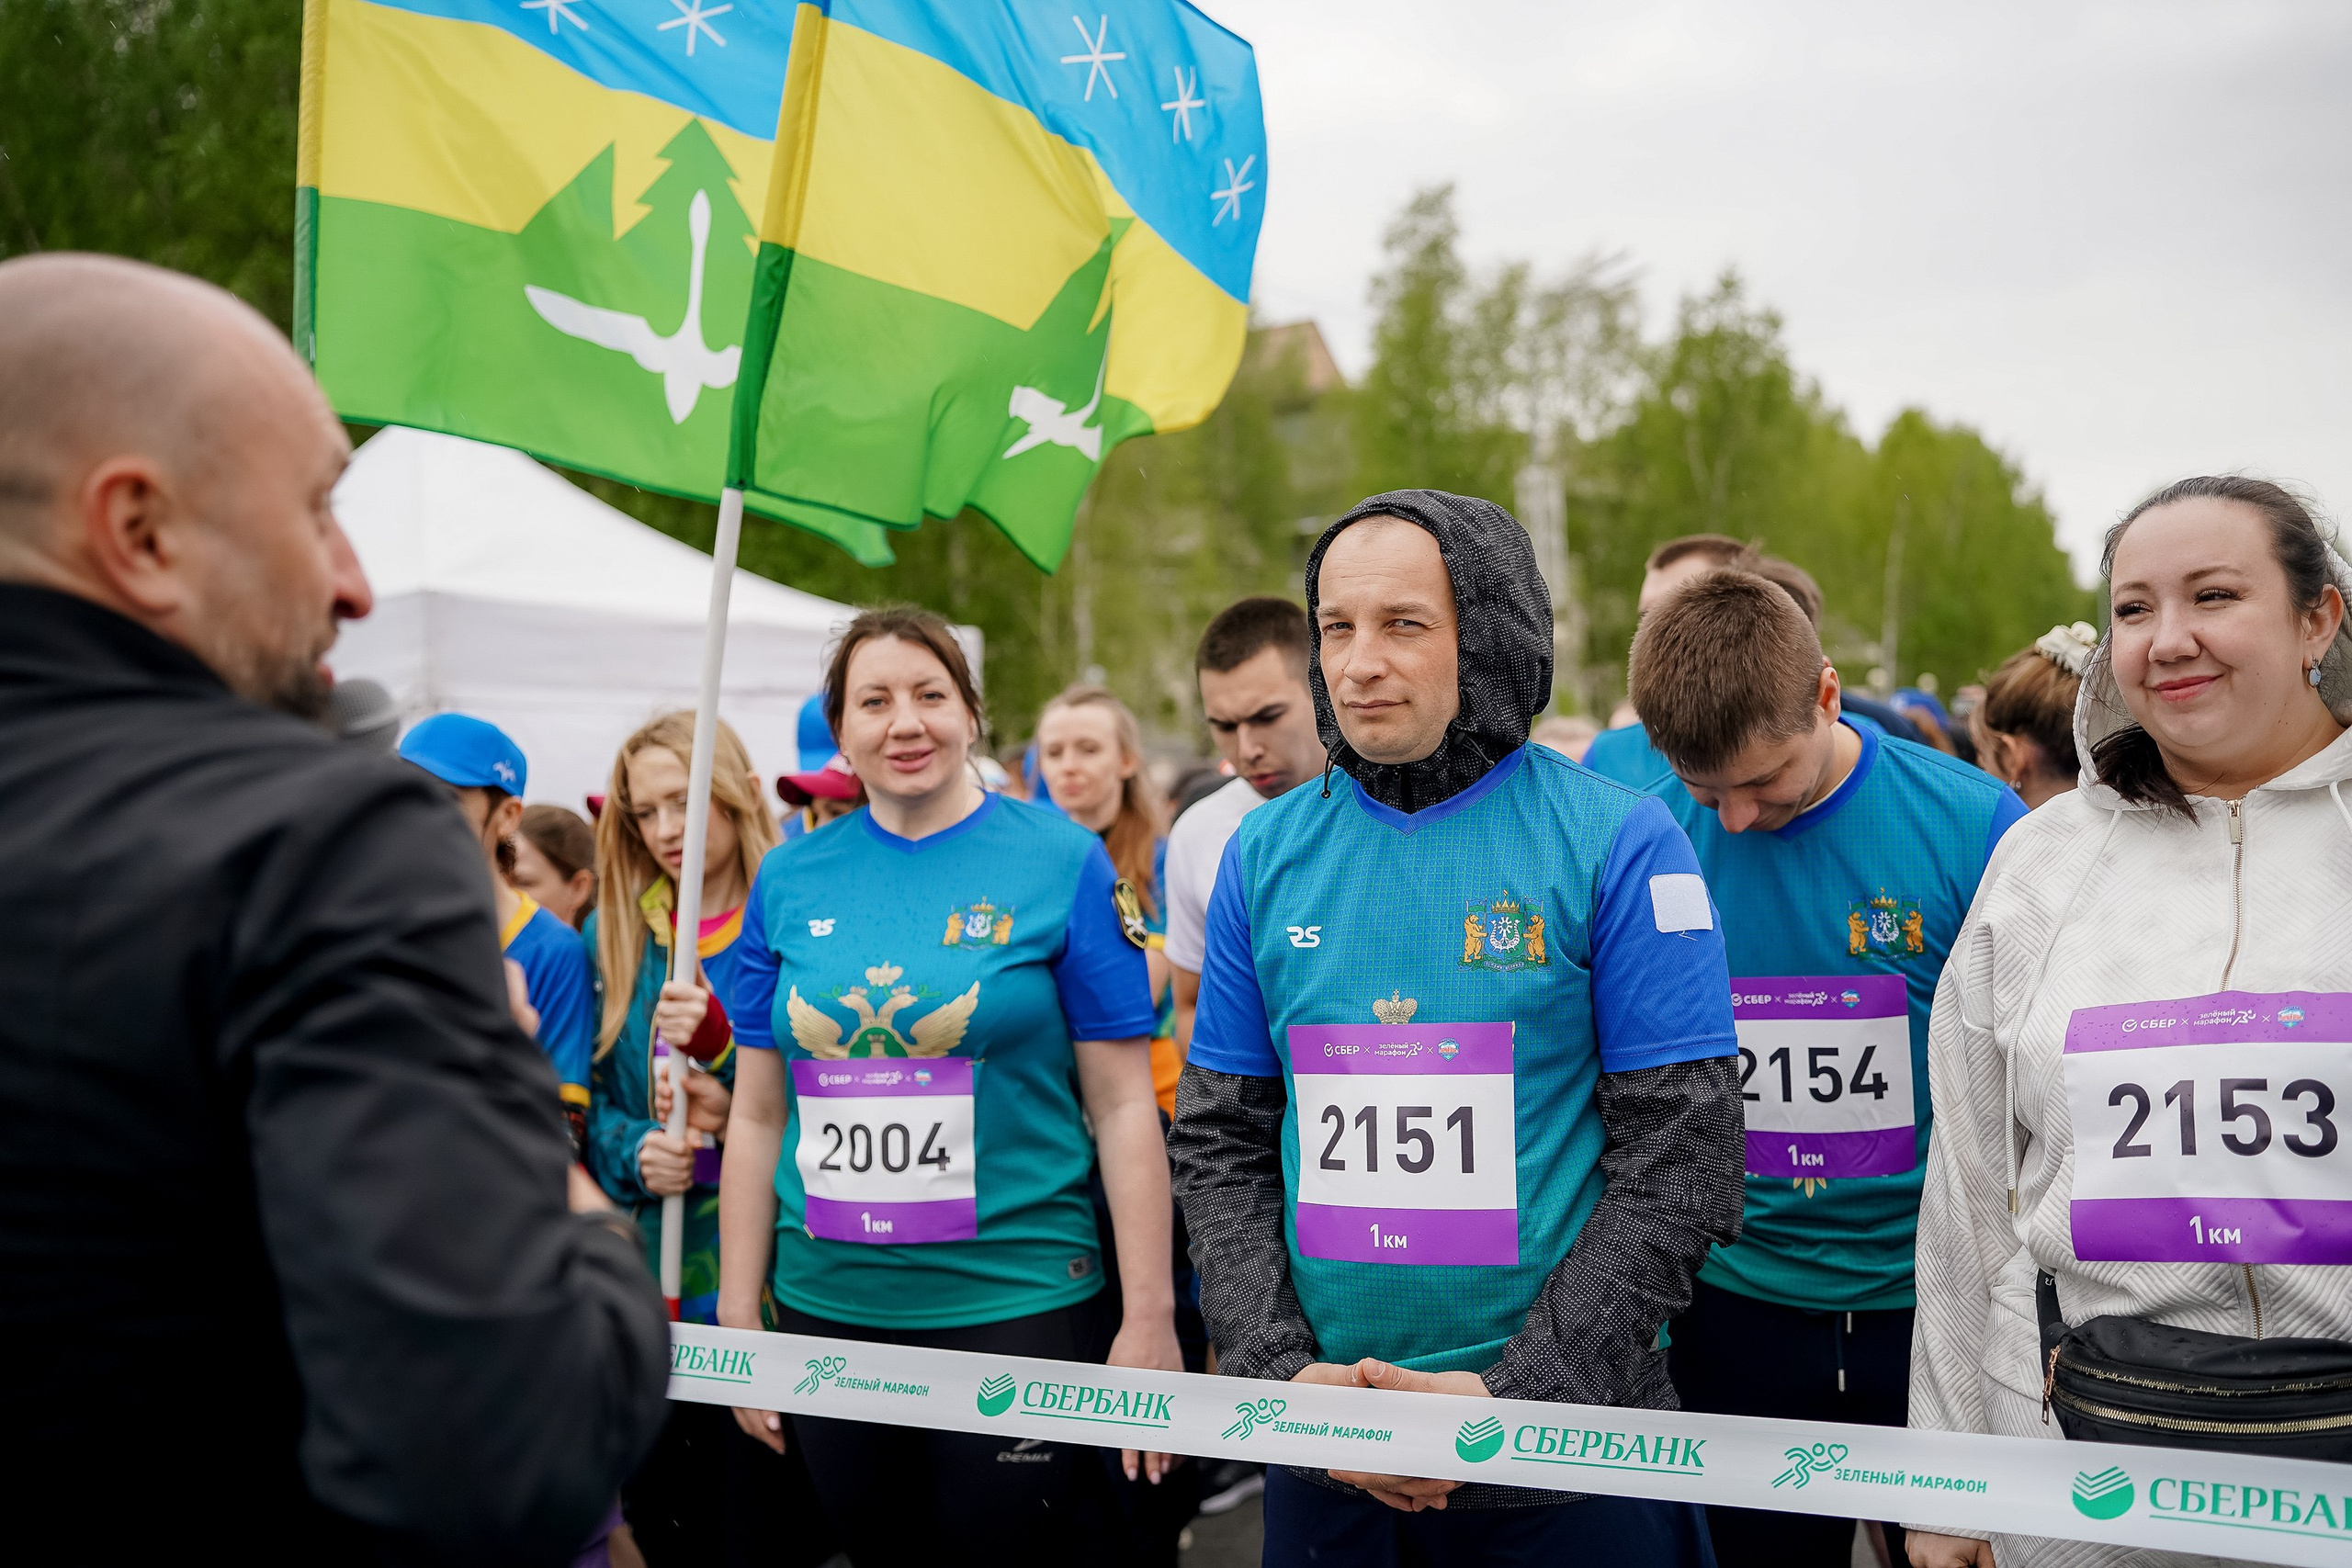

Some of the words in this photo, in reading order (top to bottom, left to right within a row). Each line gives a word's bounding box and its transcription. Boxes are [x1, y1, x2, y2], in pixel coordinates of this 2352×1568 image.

[2140, 1019, 2177, 1030] СБЕР
[2193, 1016, 2233, 1027] марафон
[1334, 1044, 1361, 1055] СБЕР
[1374, 1049, 1407, 1057] марафон
[1737, 1044, 1889, 1104] 2154
[2108, 1077, 2339, 1159] 2153
[819, 1122, 951, 1173] 2004
[1319, 1104, 1476, 1174] 2151
[834, 1376, 881, 1392] ЗЕЛЕНЫЙ
[882, 1381, 930, 1397] МАРАФОН
[1023, 1381, 1176, 1421] СБЕРБАНК
[1272, 1420, 1329, 1437] ЗЕЛЕНЫЙ
[1331, 1426, 1393, 1442] МАРАФОН
[1513, 1425, 1707, 1468] СБЕРБАНК
[1834, 1468, 1906, 1486] ЗЕЛЕНЫЙ
[1910, 1474, 1987, 1494] МАРАФОН
[2149, 1477, 2352, 1531] СБЕРБА
